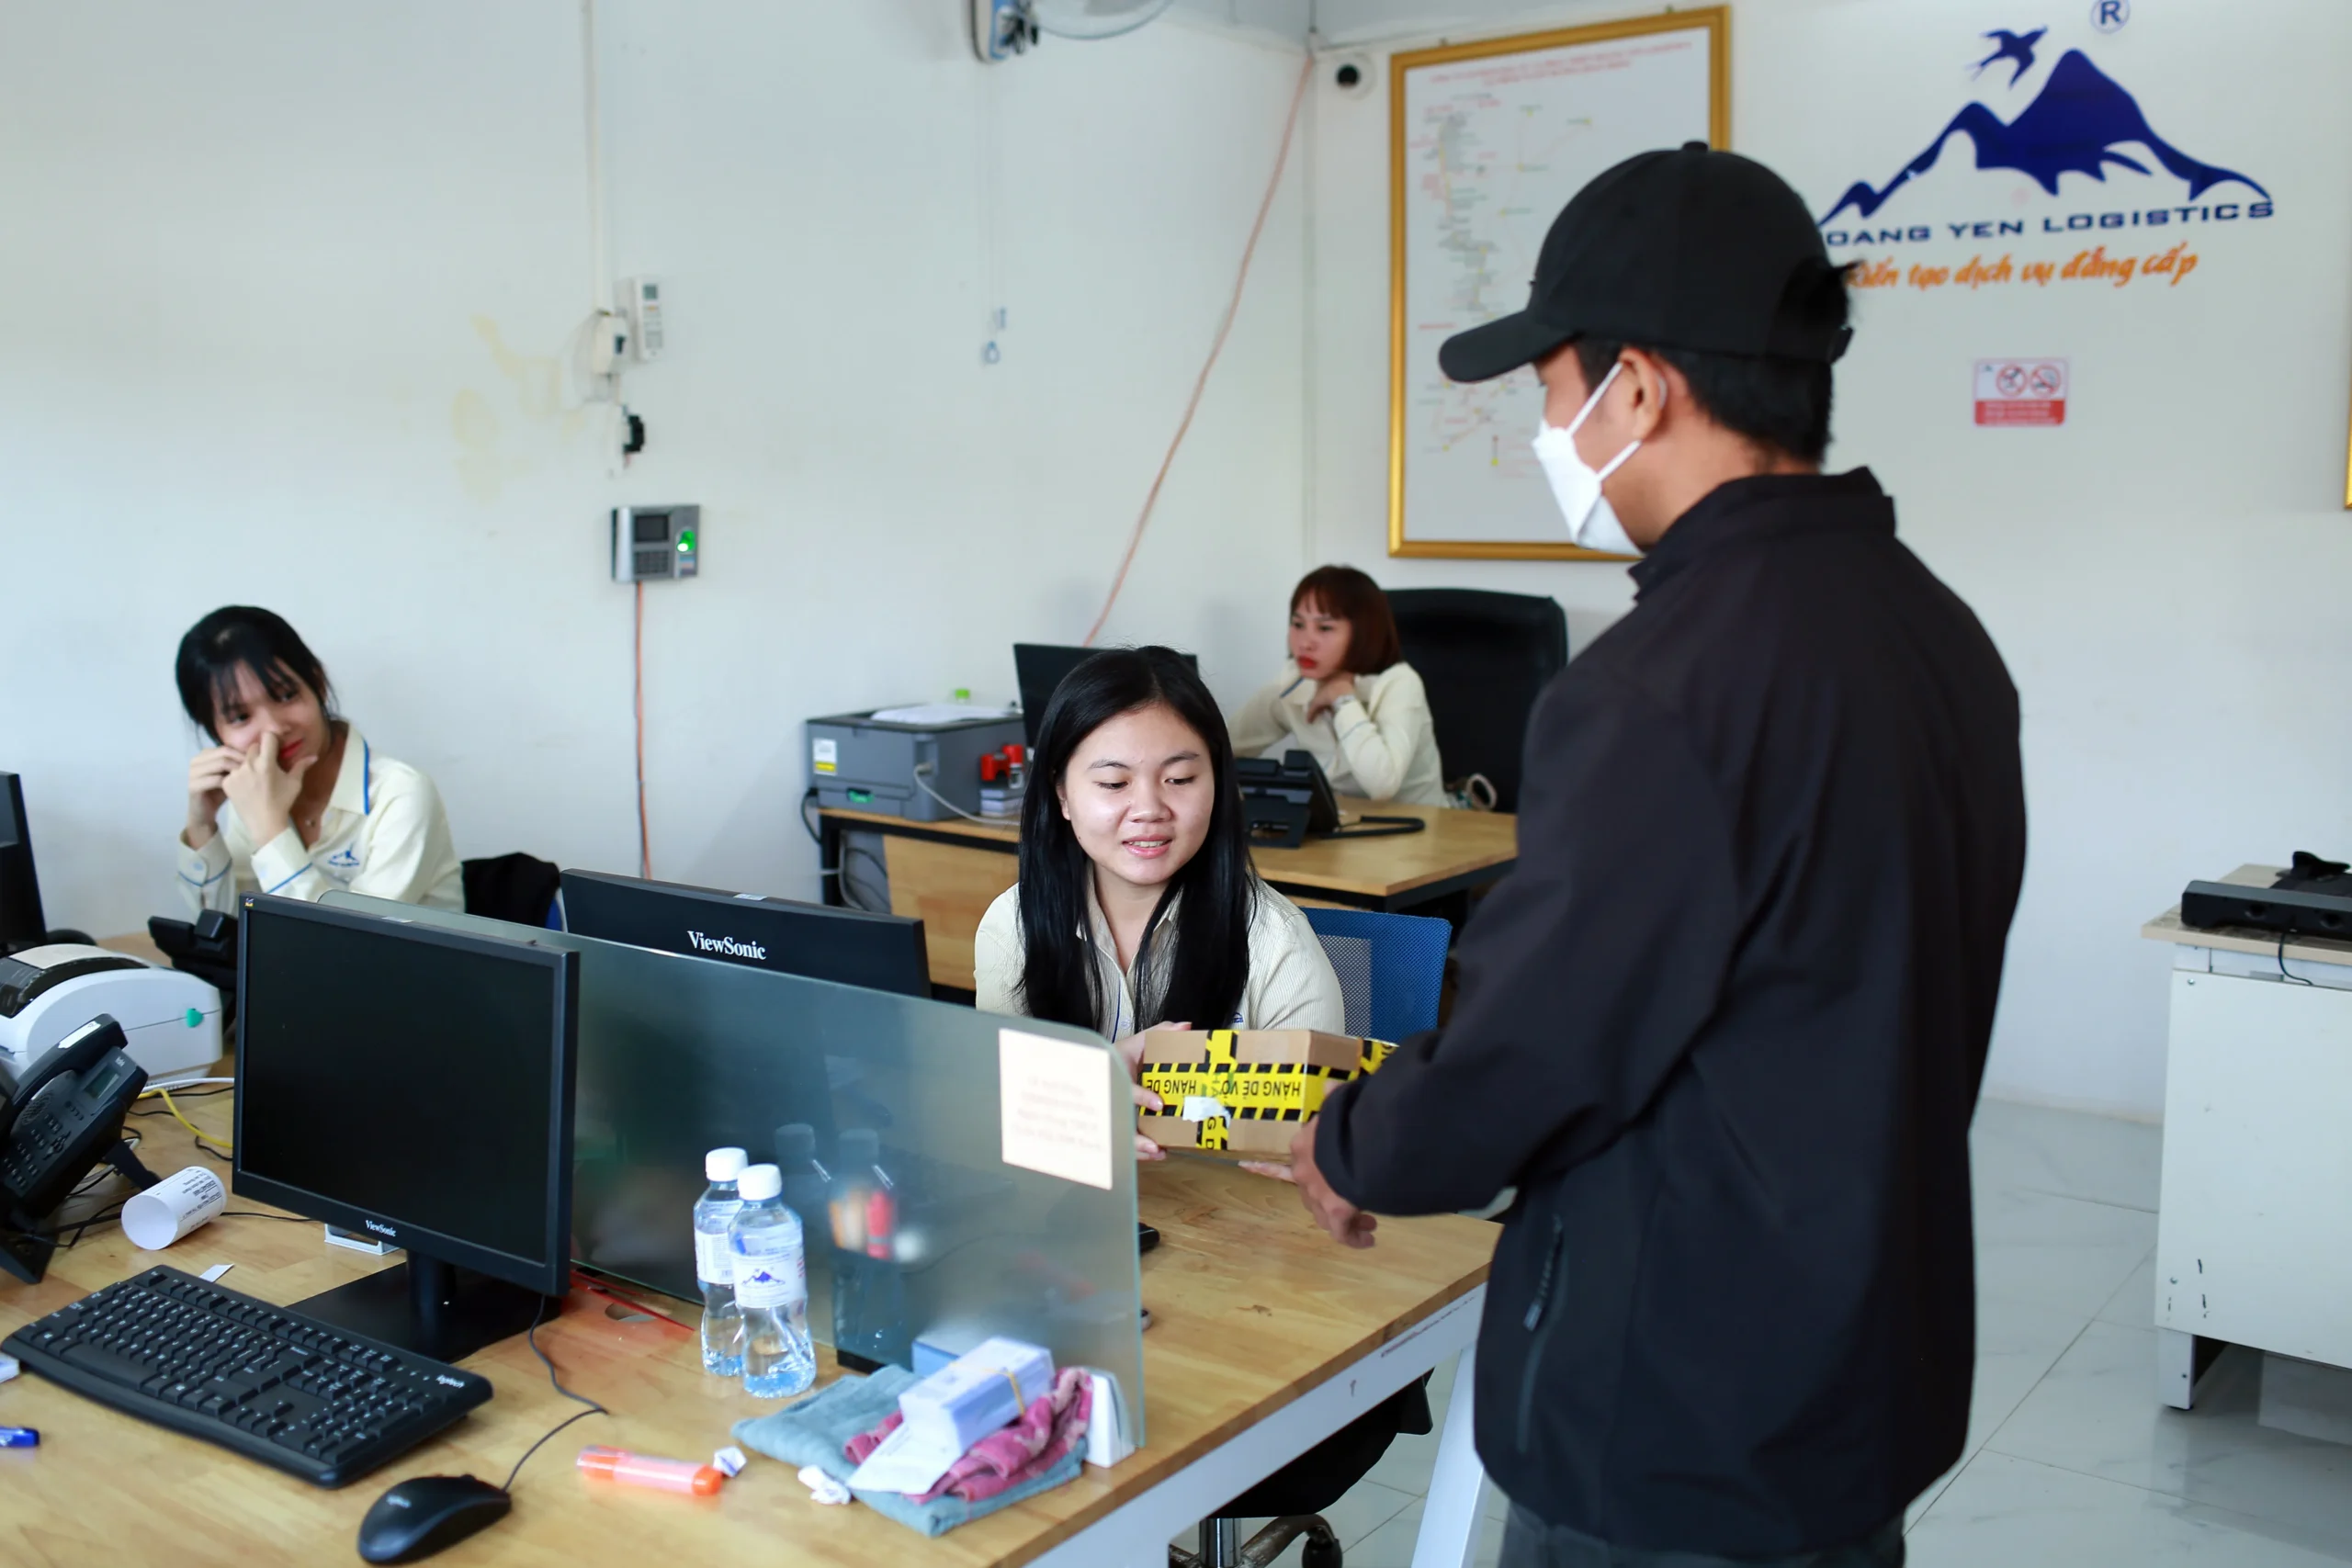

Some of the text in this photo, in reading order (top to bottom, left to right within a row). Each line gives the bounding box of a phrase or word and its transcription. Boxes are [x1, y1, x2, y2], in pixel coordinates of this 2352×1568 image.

[1826, 201, 2275, 246] OANG YEN LOGISTICS
[1908, 263, 1951, 291] tạo
[1953, 253, 2014, 289] dịch
[2142, 240, 2199, 287] cấp
[687, 930, 767, 960] ViewSonic
[365, 1219, 397, 1237] ViewSonic
